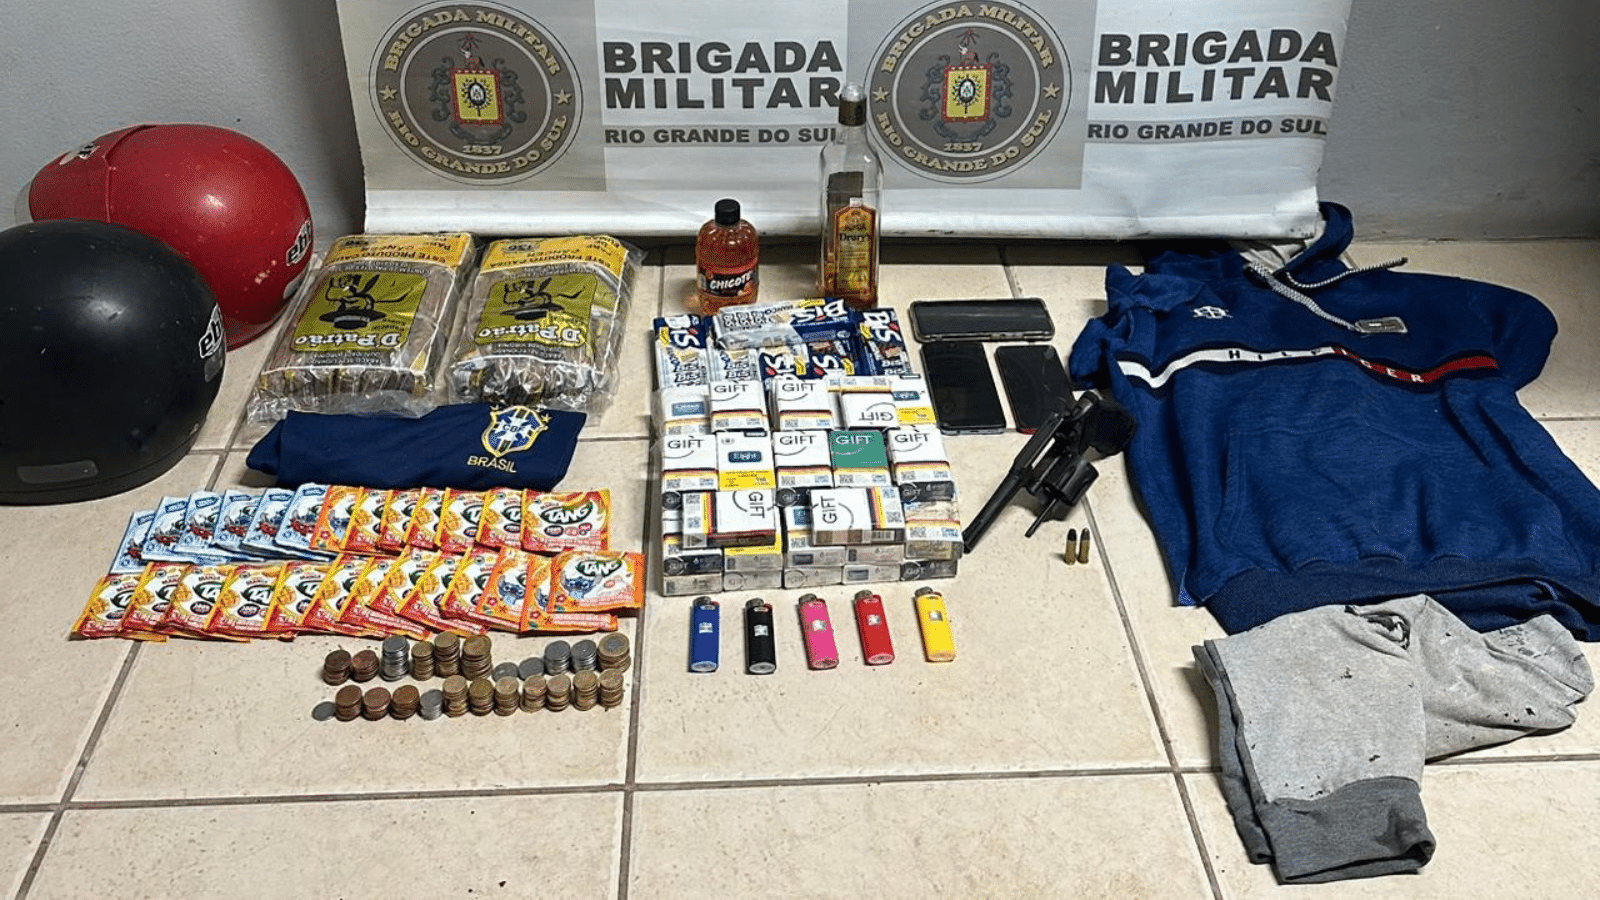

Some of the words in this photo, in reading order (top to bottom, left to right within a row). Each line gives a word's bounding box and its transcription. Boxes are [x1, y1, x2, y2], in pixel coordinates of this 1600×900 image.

[384, 9, 470, 72] BRIGADA
[476, 10, 561, 75] MILITAR
[881, 4, 973, 73] BRIGADA
[978, 4, 1055, 68] MILITAR
[603, 40, 843, 73] BRIGADA
[1098, 29, 1338, 67] BRIGADA
[605, 77, 841, 109] MILITAR
[1094, 66, 1332, 103] MILITAR
[605, 129, 645, 143] RIO
[653, 129, 750, 143] GRANDE
[758, 129, 790, 143] DO
[1087, 124, 1129, 138] RIO
[1137, 121, 1233, 139] GRANDE
[1240, 119, 1272, 134] DO
[1280, 118, 1327, 135] SUL
[388, 110, 420, 147] RIO
[422, 146, 511, 174] GRANDE
[515, 149, 540, 169] DO
[541, 115, 568, 150] SUL
[877, 112, 902, 147] RIO
[903, 145, 988, 172] GRANDE
[992, 146, 1020, 166] DO
[1021, 109, 1052, 145] SUL
[363, 251, 416, 261] PRODUTO
[714, 384, 749, 393] GIFT
[782, 383, 816, 392] GIFT
[859, 412, 894, 421] GIFT
[667, 440, 704, 449] GIFT
[779, 435, 816, 445] GIFT
[836, 435, 872, 445] GIFT
[894, 433, 930, 443] GIFT
[467, 456, 517, 473] BRASIL
[748, 491, 765, 519] GIFT
[821, 496, 838, 524] GIFT
[545, 506, 588, 522] TANG
[581, 560, 621, 576] TANG
